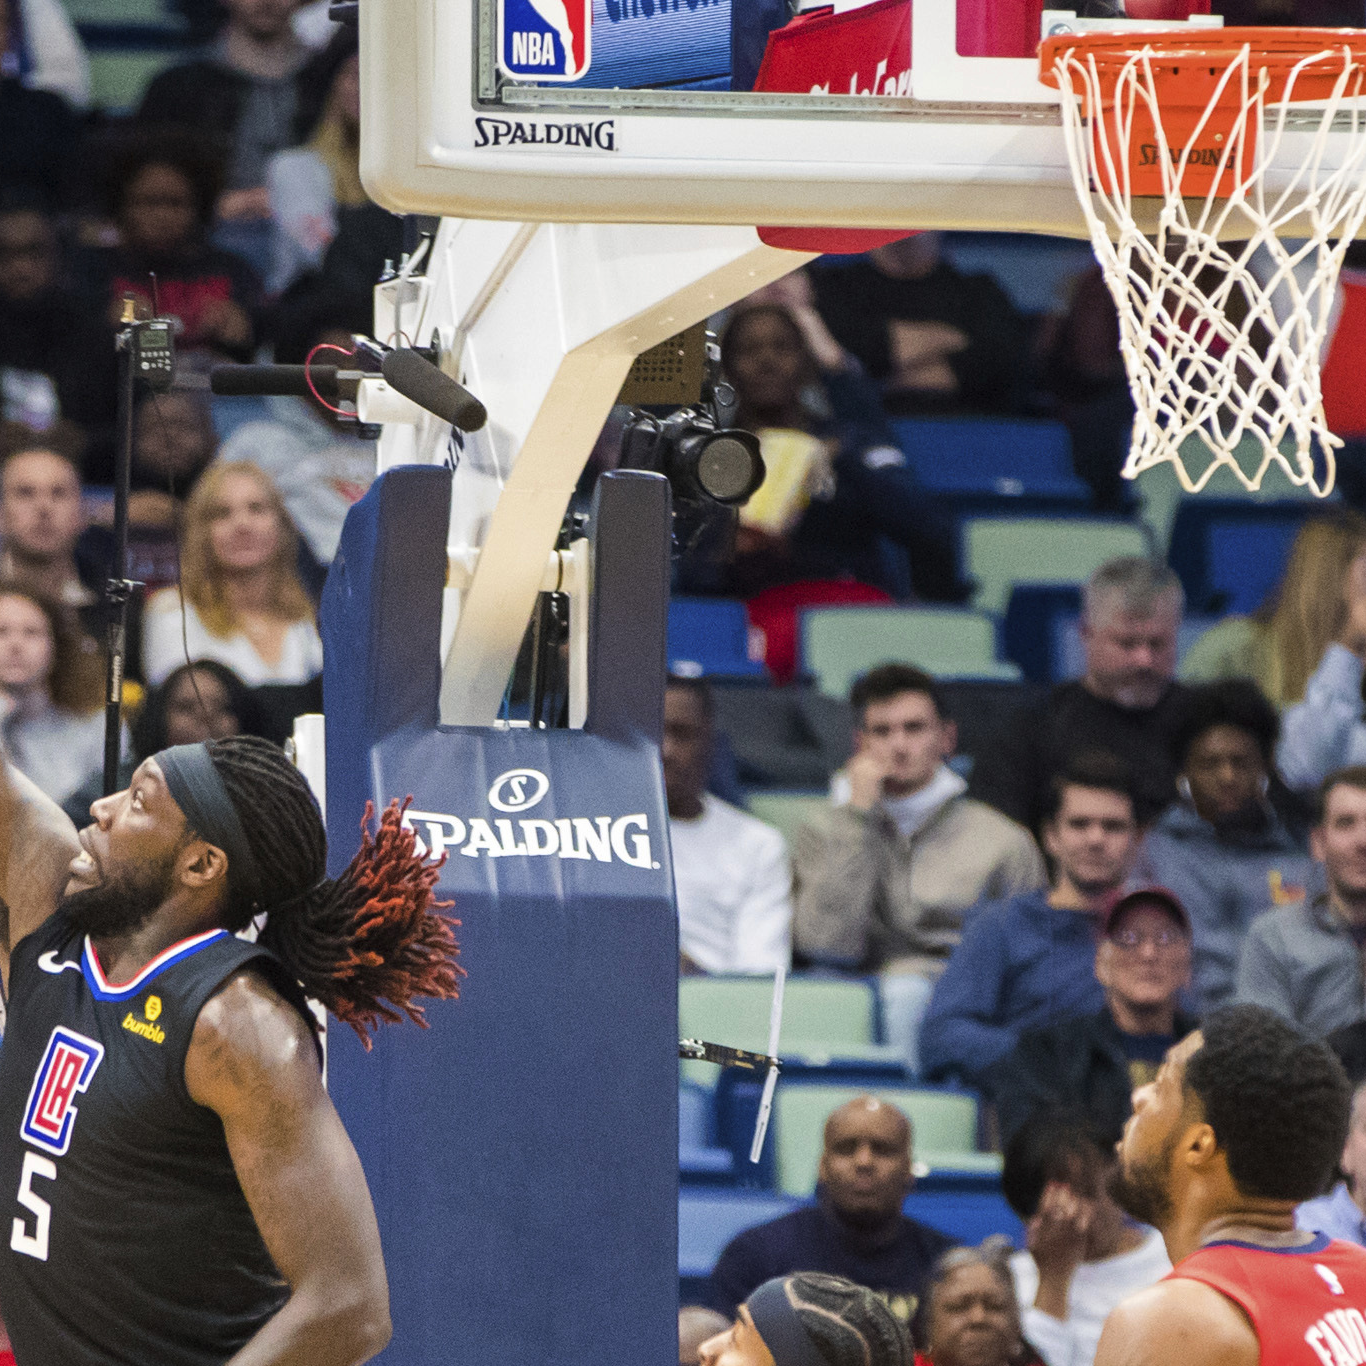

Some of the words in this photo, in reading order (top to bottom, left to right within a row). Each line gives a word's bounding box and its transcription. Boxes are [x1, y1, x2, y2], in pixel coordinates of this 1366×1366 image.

[512, 32, 556, 66] NBA
[474, 117, 616, 152] SPALDING
[122, 1012, 166, 1044] bumble
[10, 1150, 57, 1262] 5
